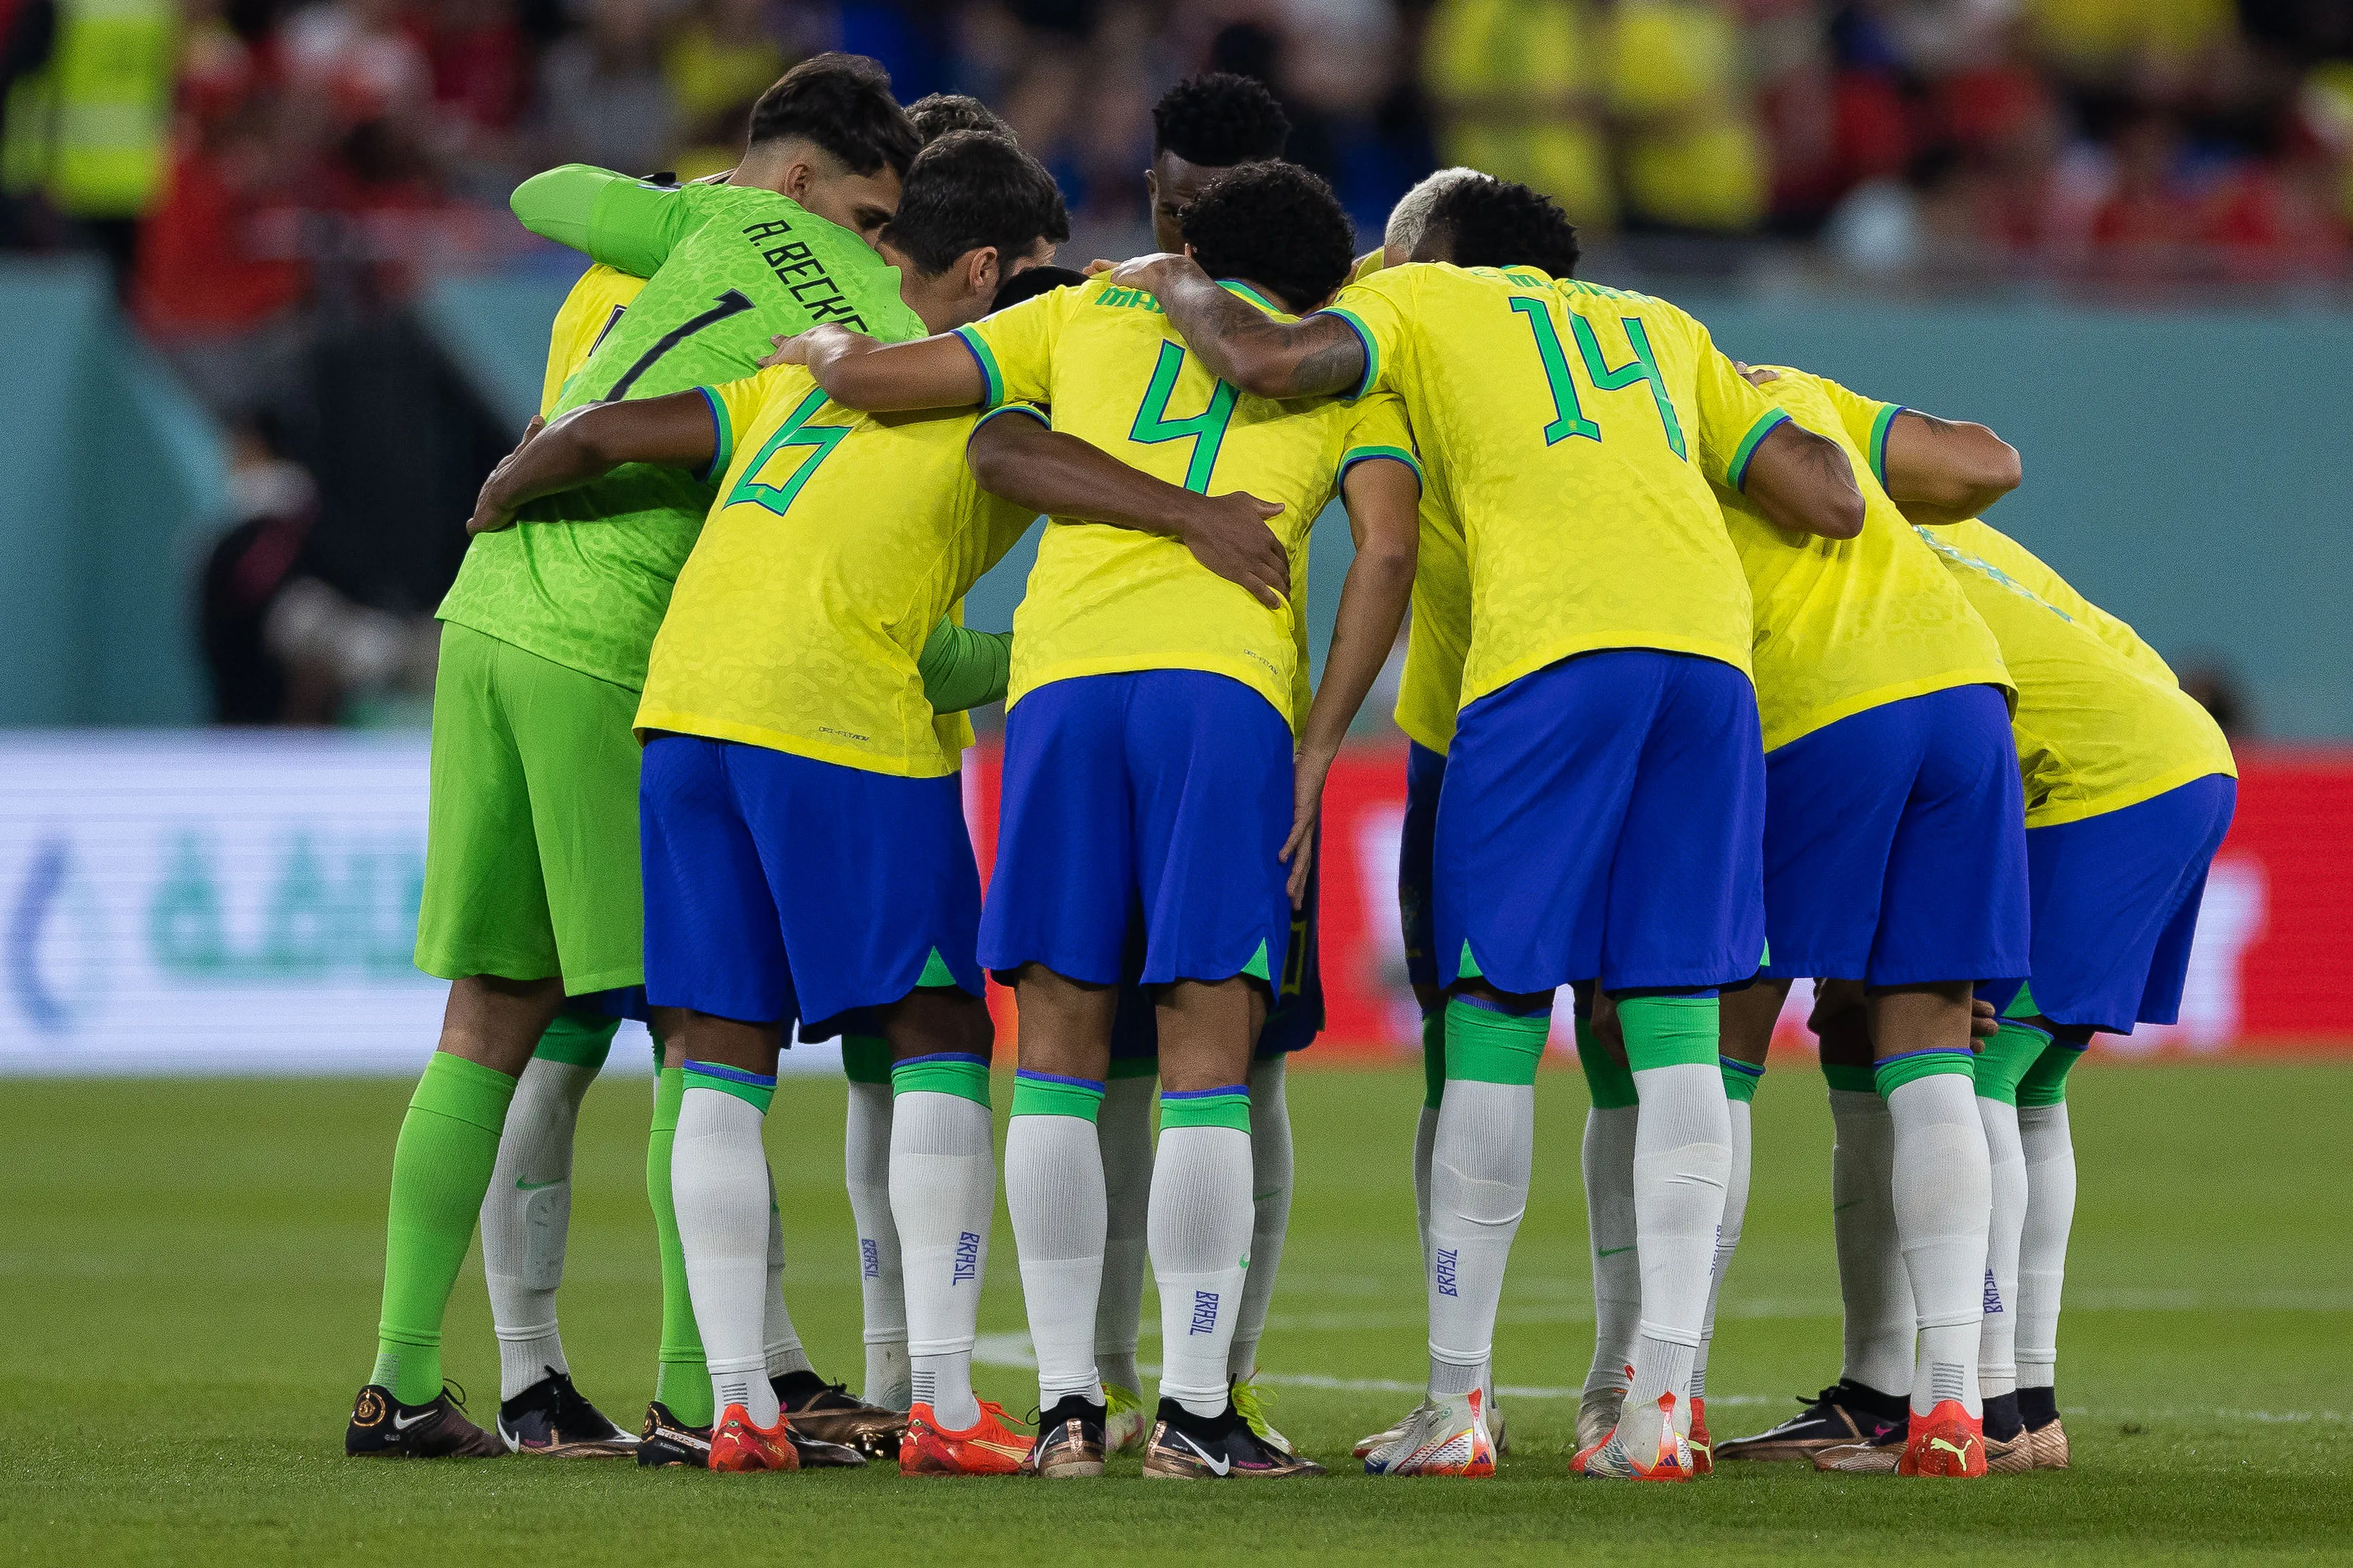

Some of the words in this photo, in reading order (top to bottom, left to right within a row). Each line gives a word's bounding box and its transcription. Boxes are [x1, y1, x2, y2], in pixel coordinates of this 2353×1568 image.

[1095, 286, 1165, 314] MA
[591, 288, 756, 402] 1
[1508, 296, 1688, 463] 14
[1128, 339, 1241, 496] 4
[721, 386, 855, 517] 6
[861, 1237, 880, 1280] BRASIL
[952, 1231, 981, 1286] BRASIL
[1437, 1248, 1458, 1297] BRASIL
[1189, 1290, 1220, 1336] BRASIL
